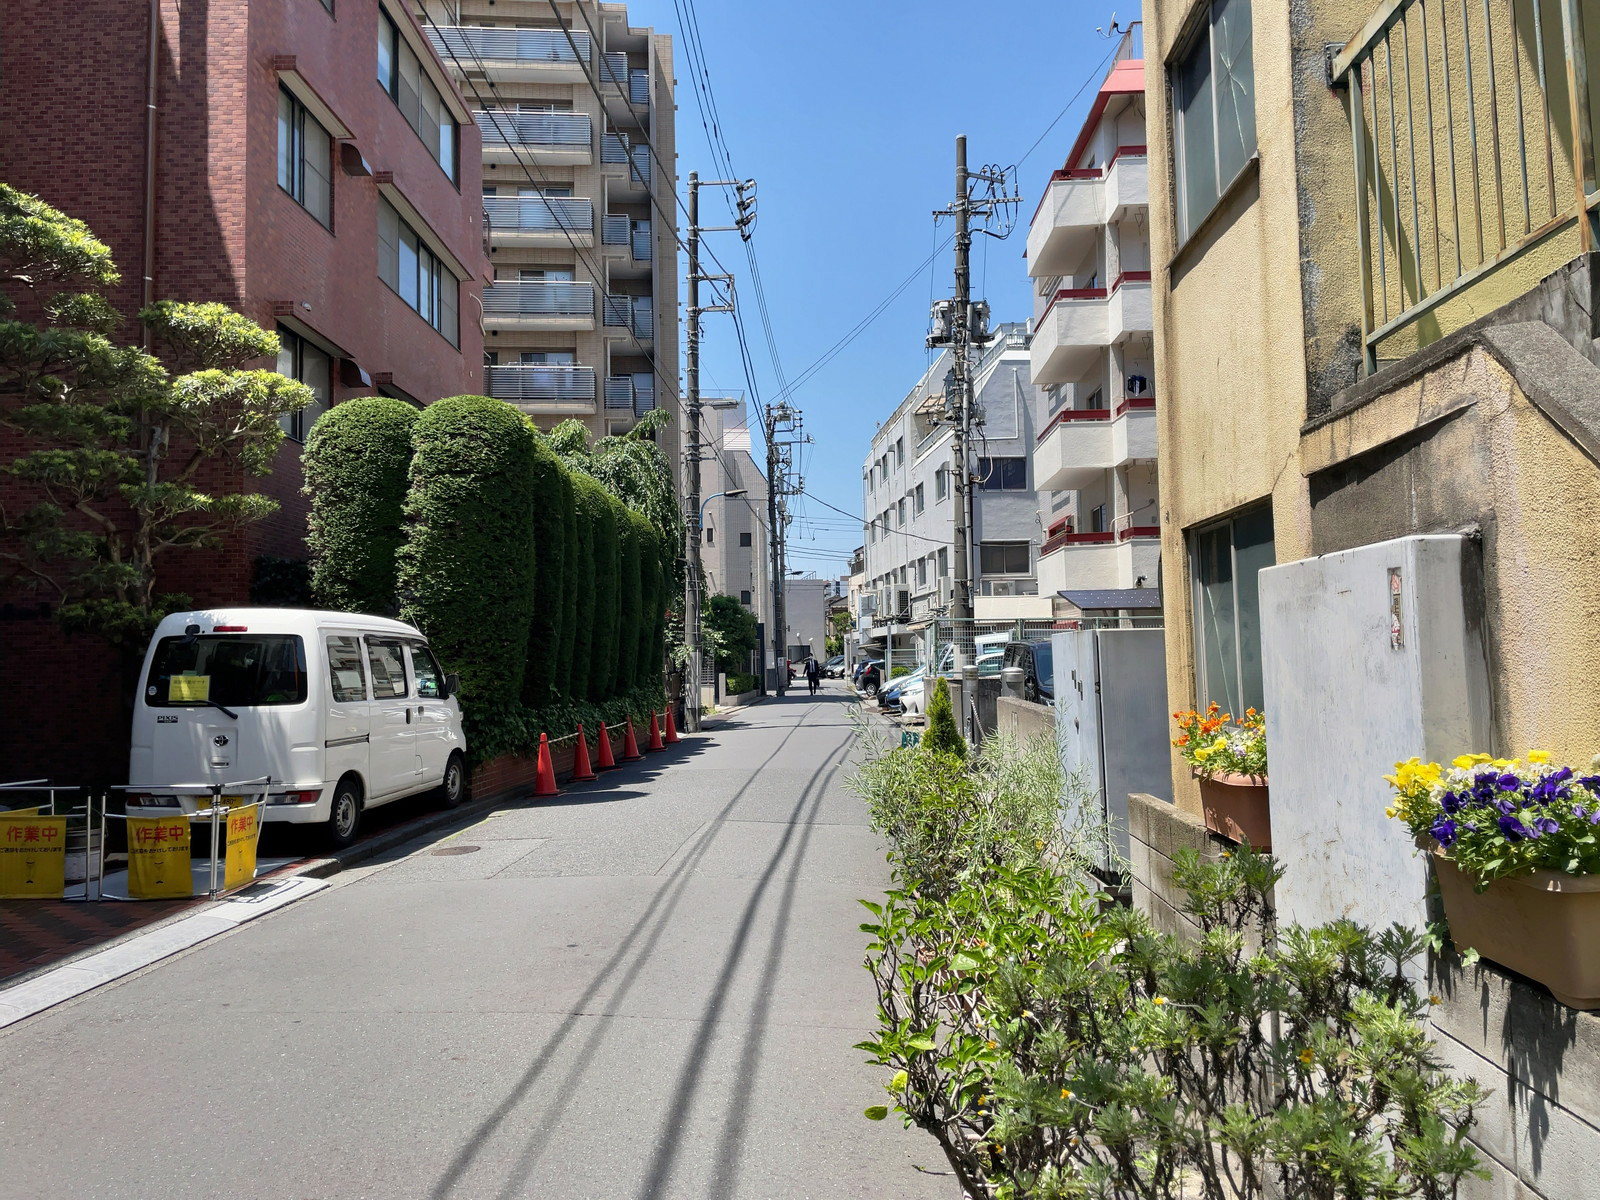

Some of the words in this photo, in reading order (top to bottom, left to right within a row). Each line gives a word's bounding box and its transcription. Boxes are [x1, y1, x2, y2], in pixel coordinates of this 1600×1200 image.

[7, 825, 58, 842] 作業中
[136, 825, 184, 843] 作業中
[231, 815, 254, 835] 作業中
